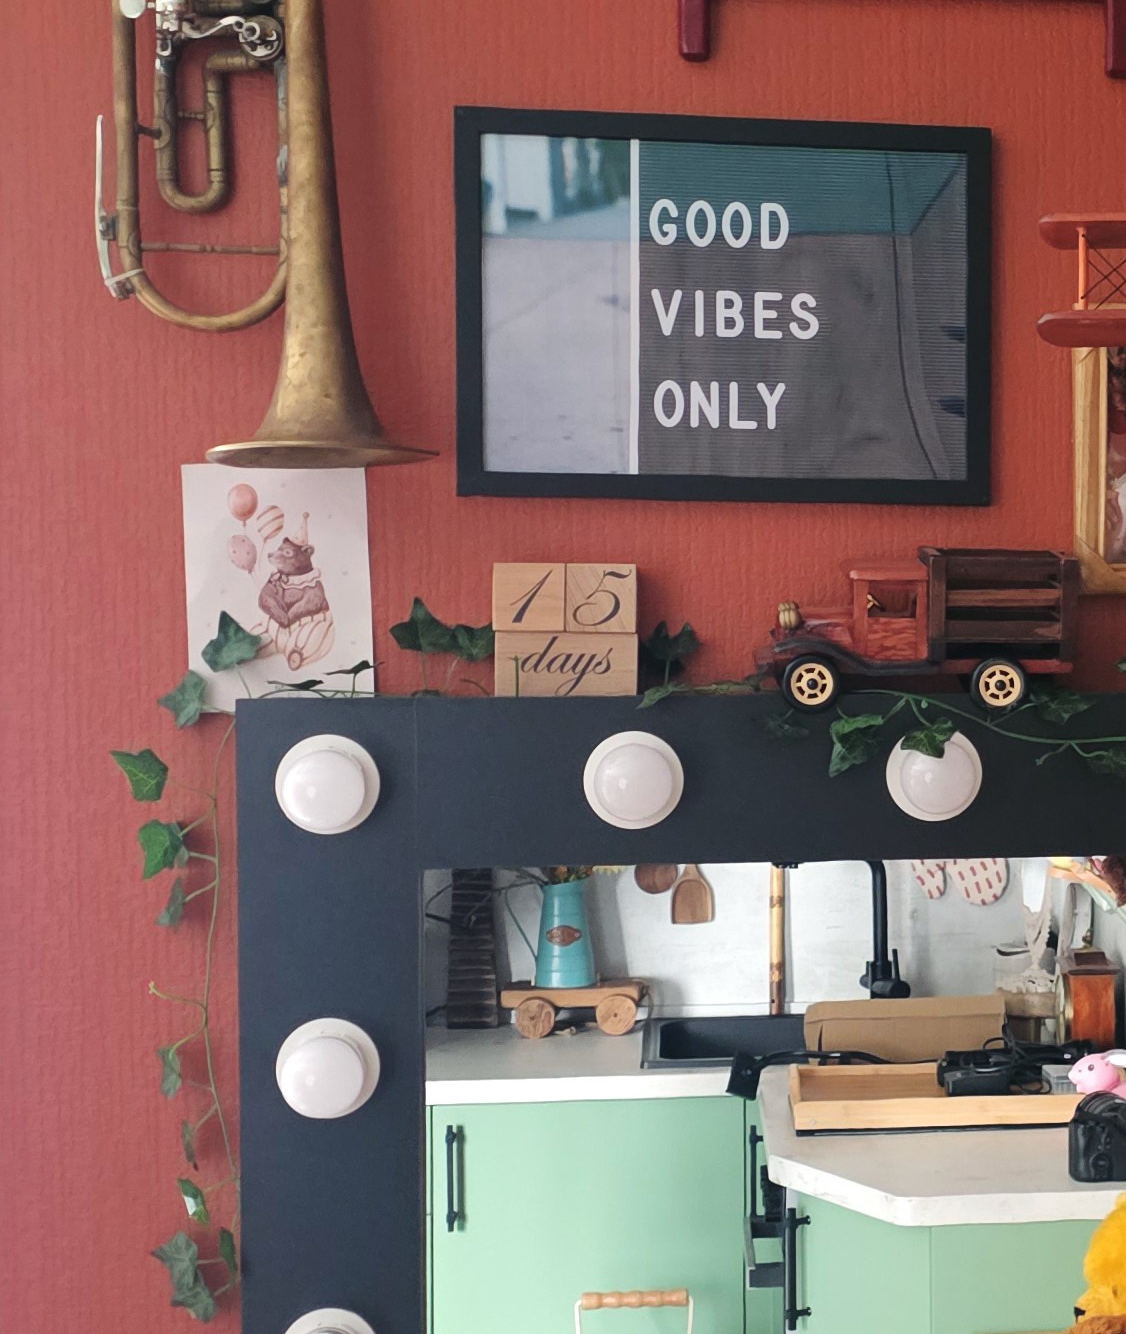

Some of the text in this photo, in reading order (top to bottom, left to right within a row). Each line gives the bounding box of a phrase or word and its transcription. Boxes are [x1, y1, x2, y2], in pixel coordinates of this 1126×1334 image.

[649, 198, 790, 250] GOOD
[650, 288, 820, 340] VIBES
[653, 379, 787, 430] ONLY
[519, 635, 614, 696] days
